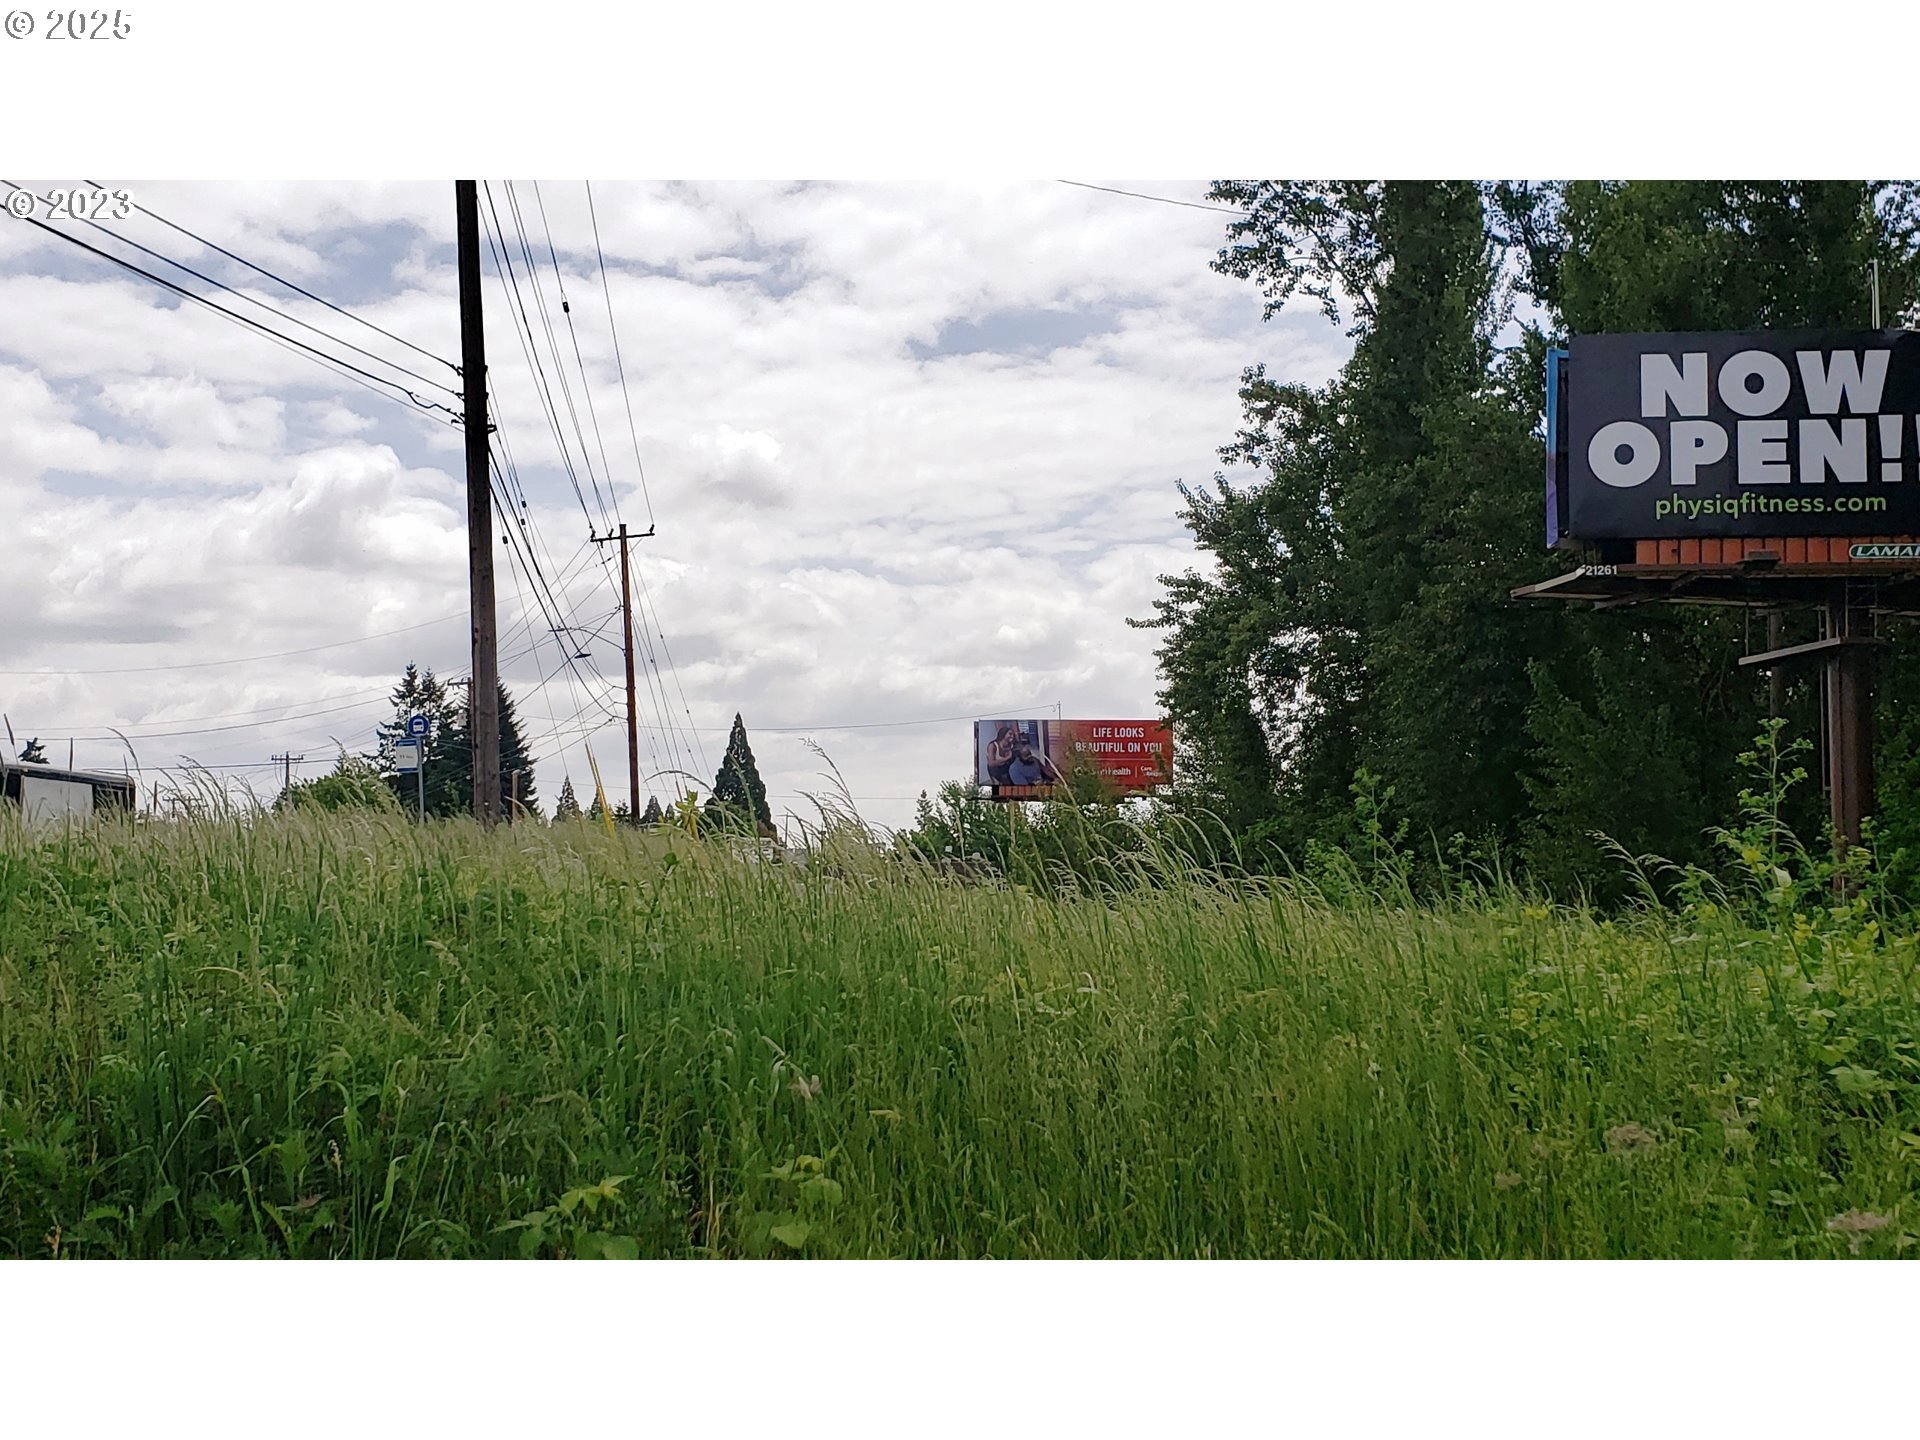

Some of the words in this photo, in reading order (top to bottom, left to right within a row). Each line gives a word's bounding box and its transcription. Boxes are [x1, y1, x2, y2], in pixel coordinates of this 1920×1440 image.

[1640, 350, 1891, 418] NOW
[1588, 414, 1920, 488] OPEN!
[1655, 492, 1887, 520] physiqfitness.com
[1585, 564, 1617, 576] 21261
[1093, 727, 1112, 738] LIFE
[1114, 727, 1144, 738] LOOKS
[1075, 742, 1125, 752] BEAUTIFUL
[1127, 742, 1141, 752] ON
[1143, 742, 1162, 752] YOU
